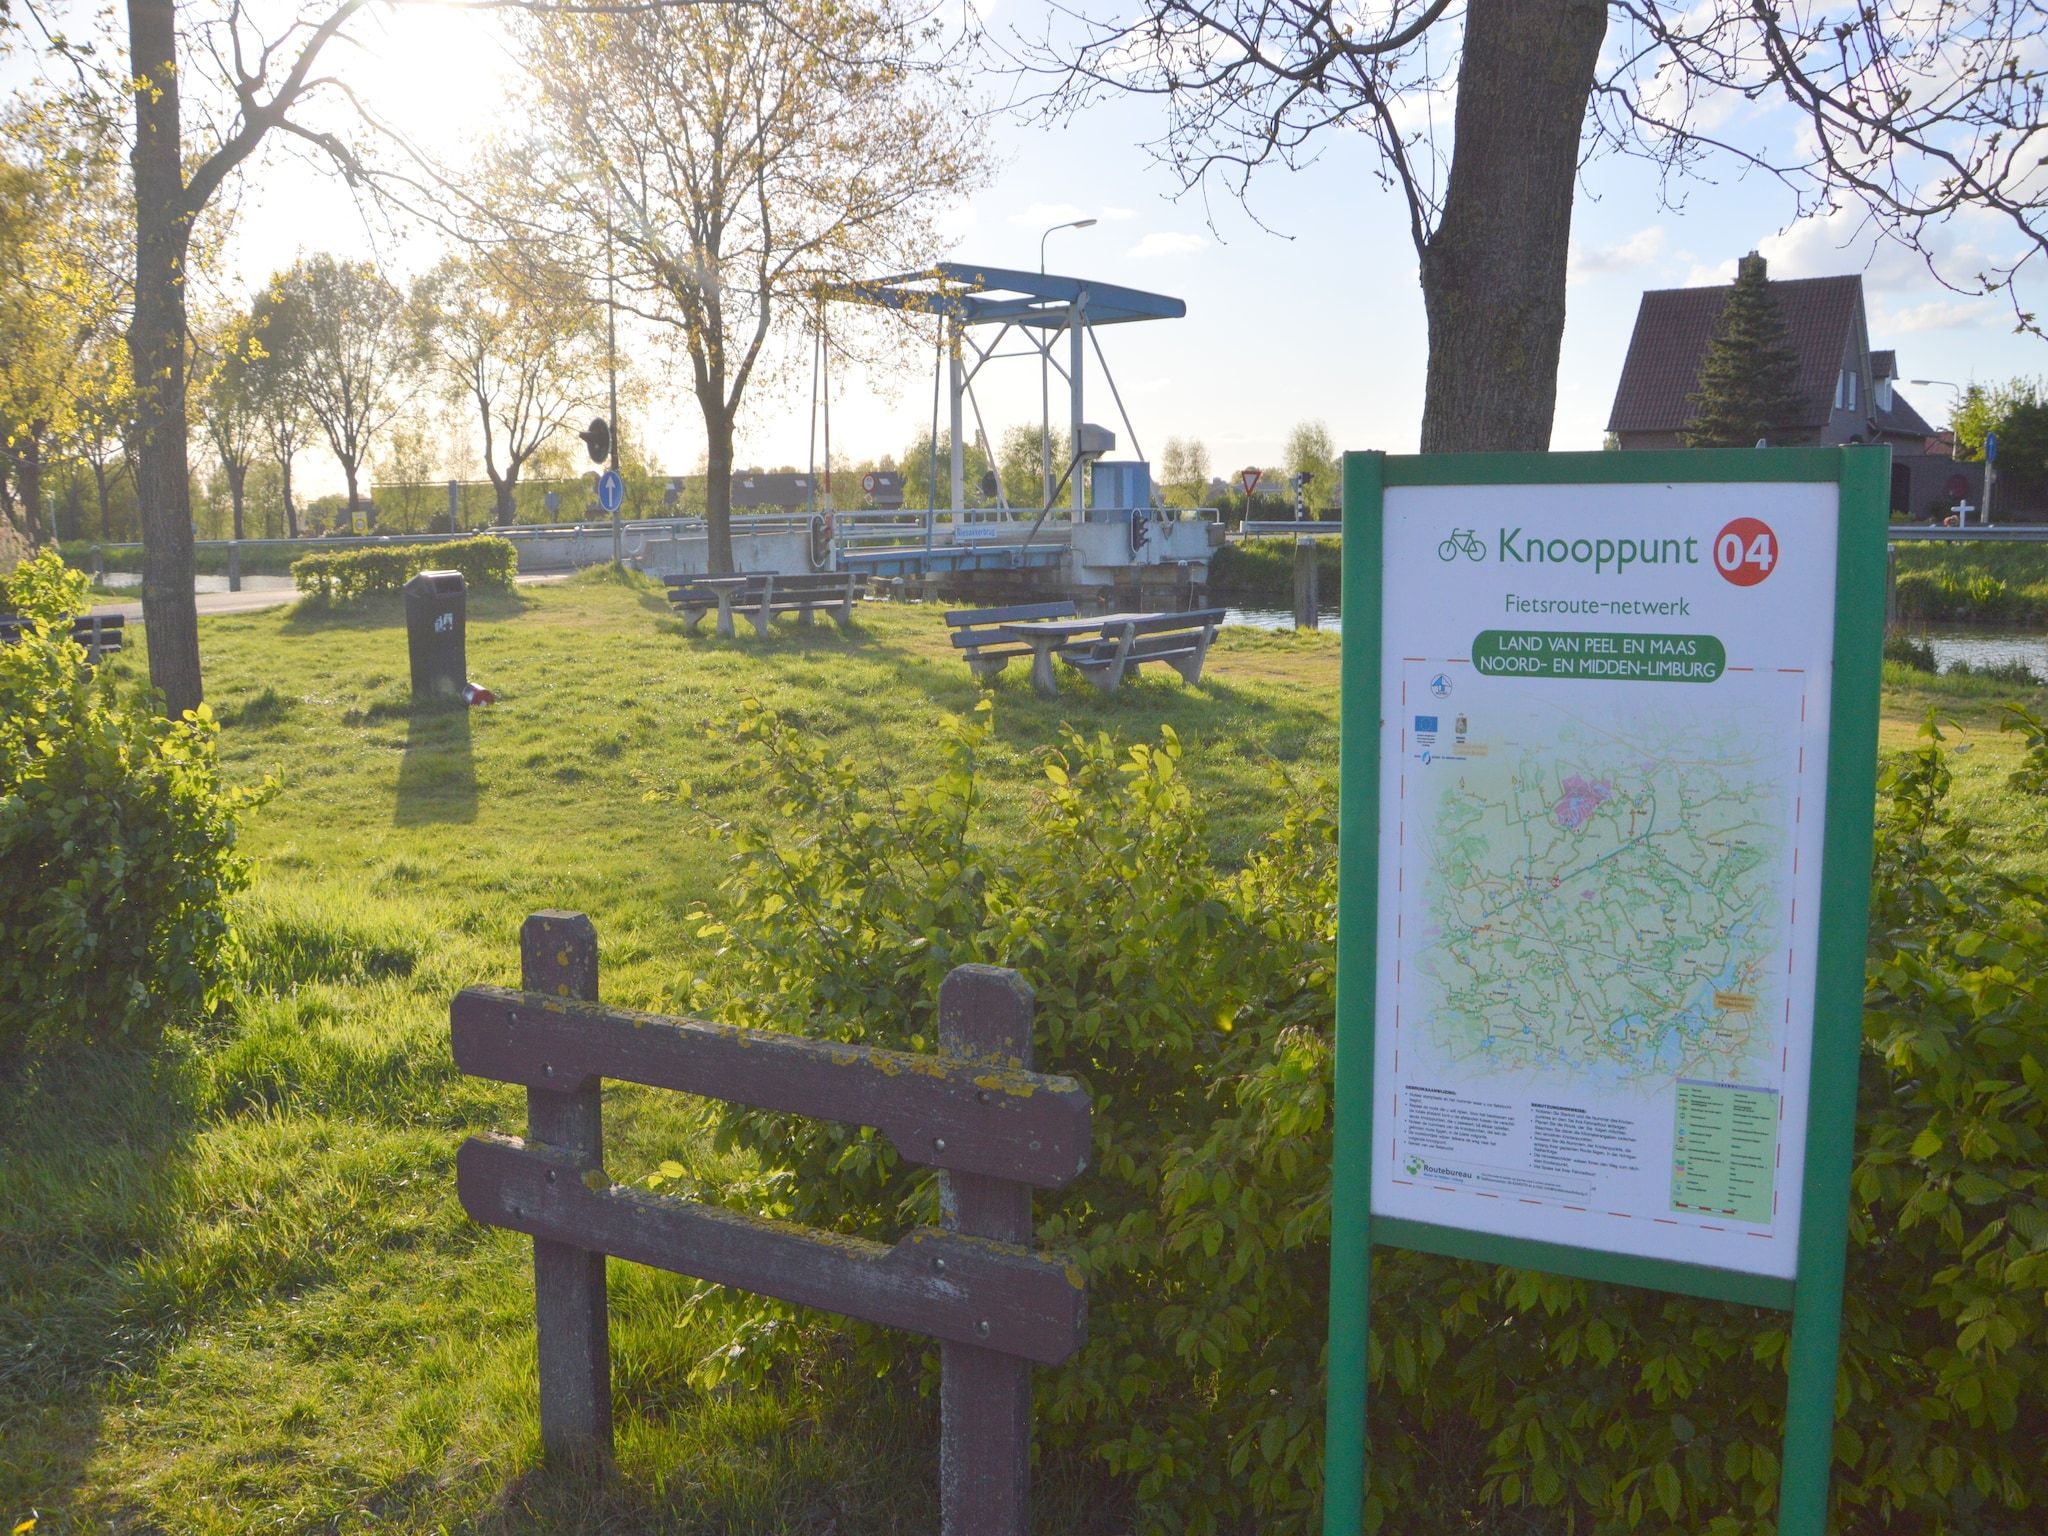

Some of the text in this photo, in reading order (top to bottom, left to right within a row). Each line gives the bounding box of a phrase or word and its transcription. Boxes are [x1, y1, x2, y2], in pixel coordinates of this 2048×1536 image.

[1499, 527, 1773, 575] Knooppunt 04
[1505, 593, 1690, 616] Fietsroute-netwerk
[1499, 636, 1697, 656] LAND VAN PEEL EN MAAS
[1480, 656, 1716, 678] NOORD- EN MIDDEN-LIMBURG
[1423, 1164, 1473, 1179] Routebureau
